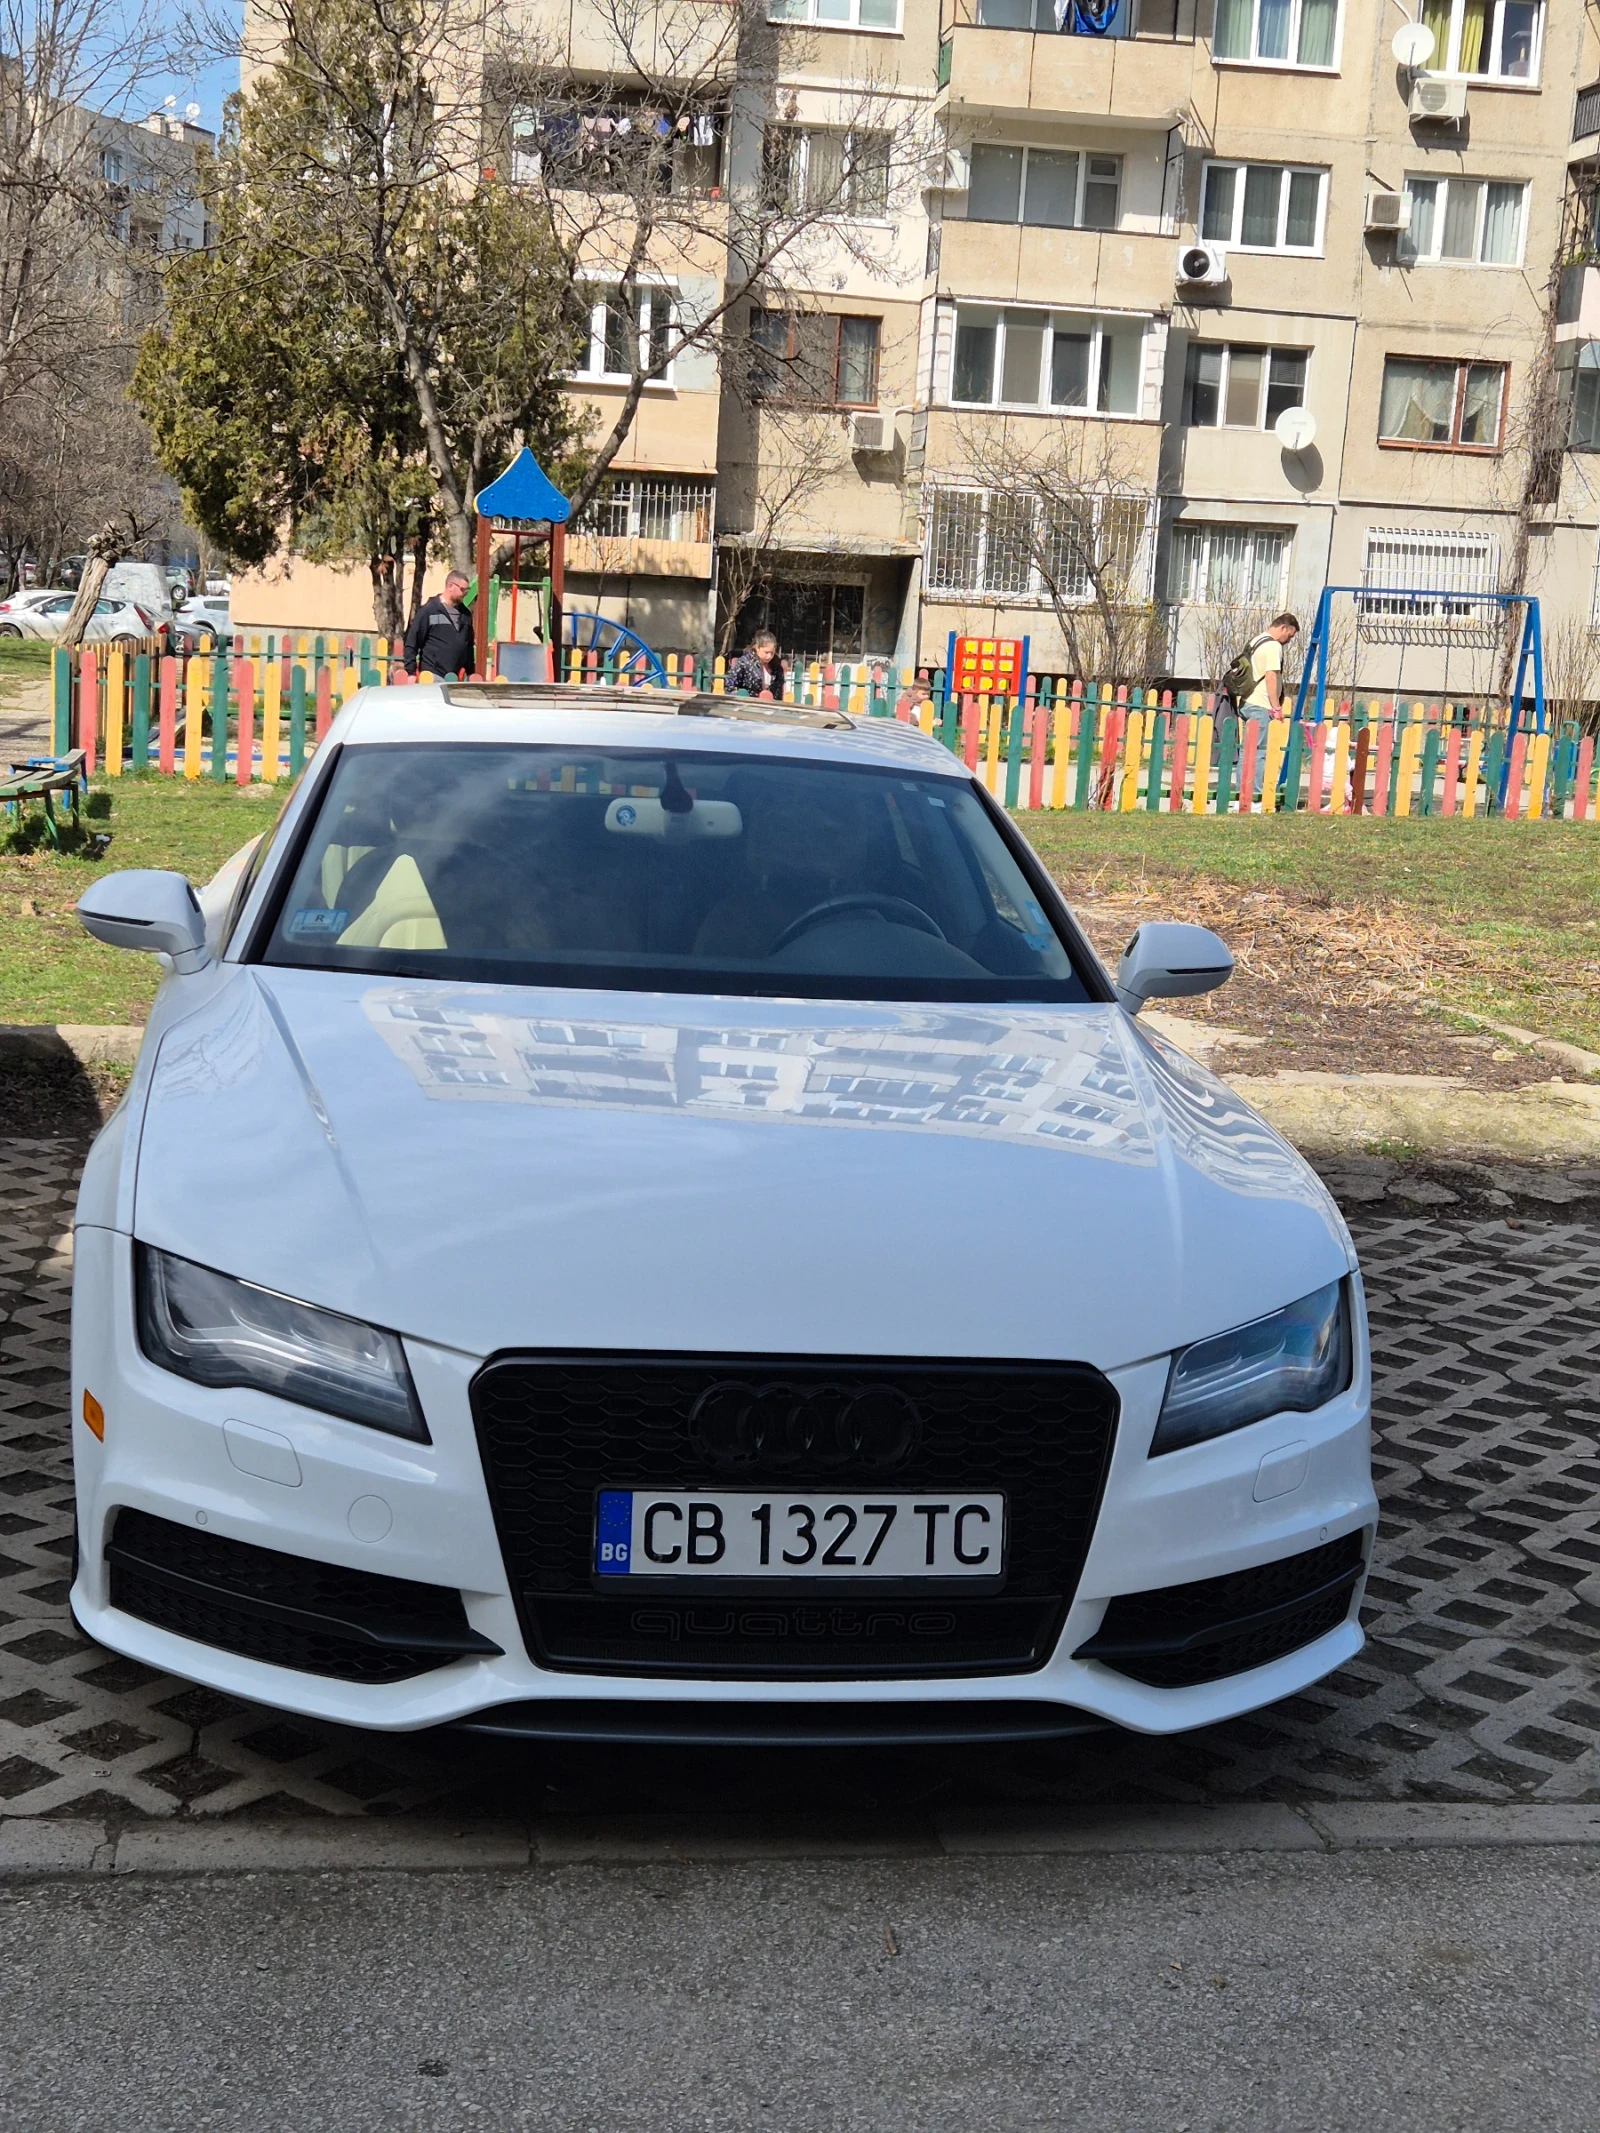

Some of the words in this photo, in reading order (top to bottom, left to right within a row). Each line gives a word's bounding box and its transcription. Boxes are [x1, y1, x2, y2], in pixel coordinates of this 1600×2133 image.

[643, 1501, 726, 1565] CB
[751, 1503, 898, 1567] 1327
[913, 1504, 991, 1567] TC
[601, 1542, 628, 1562] BG
[631, 1607, 956, 1641] quattro
